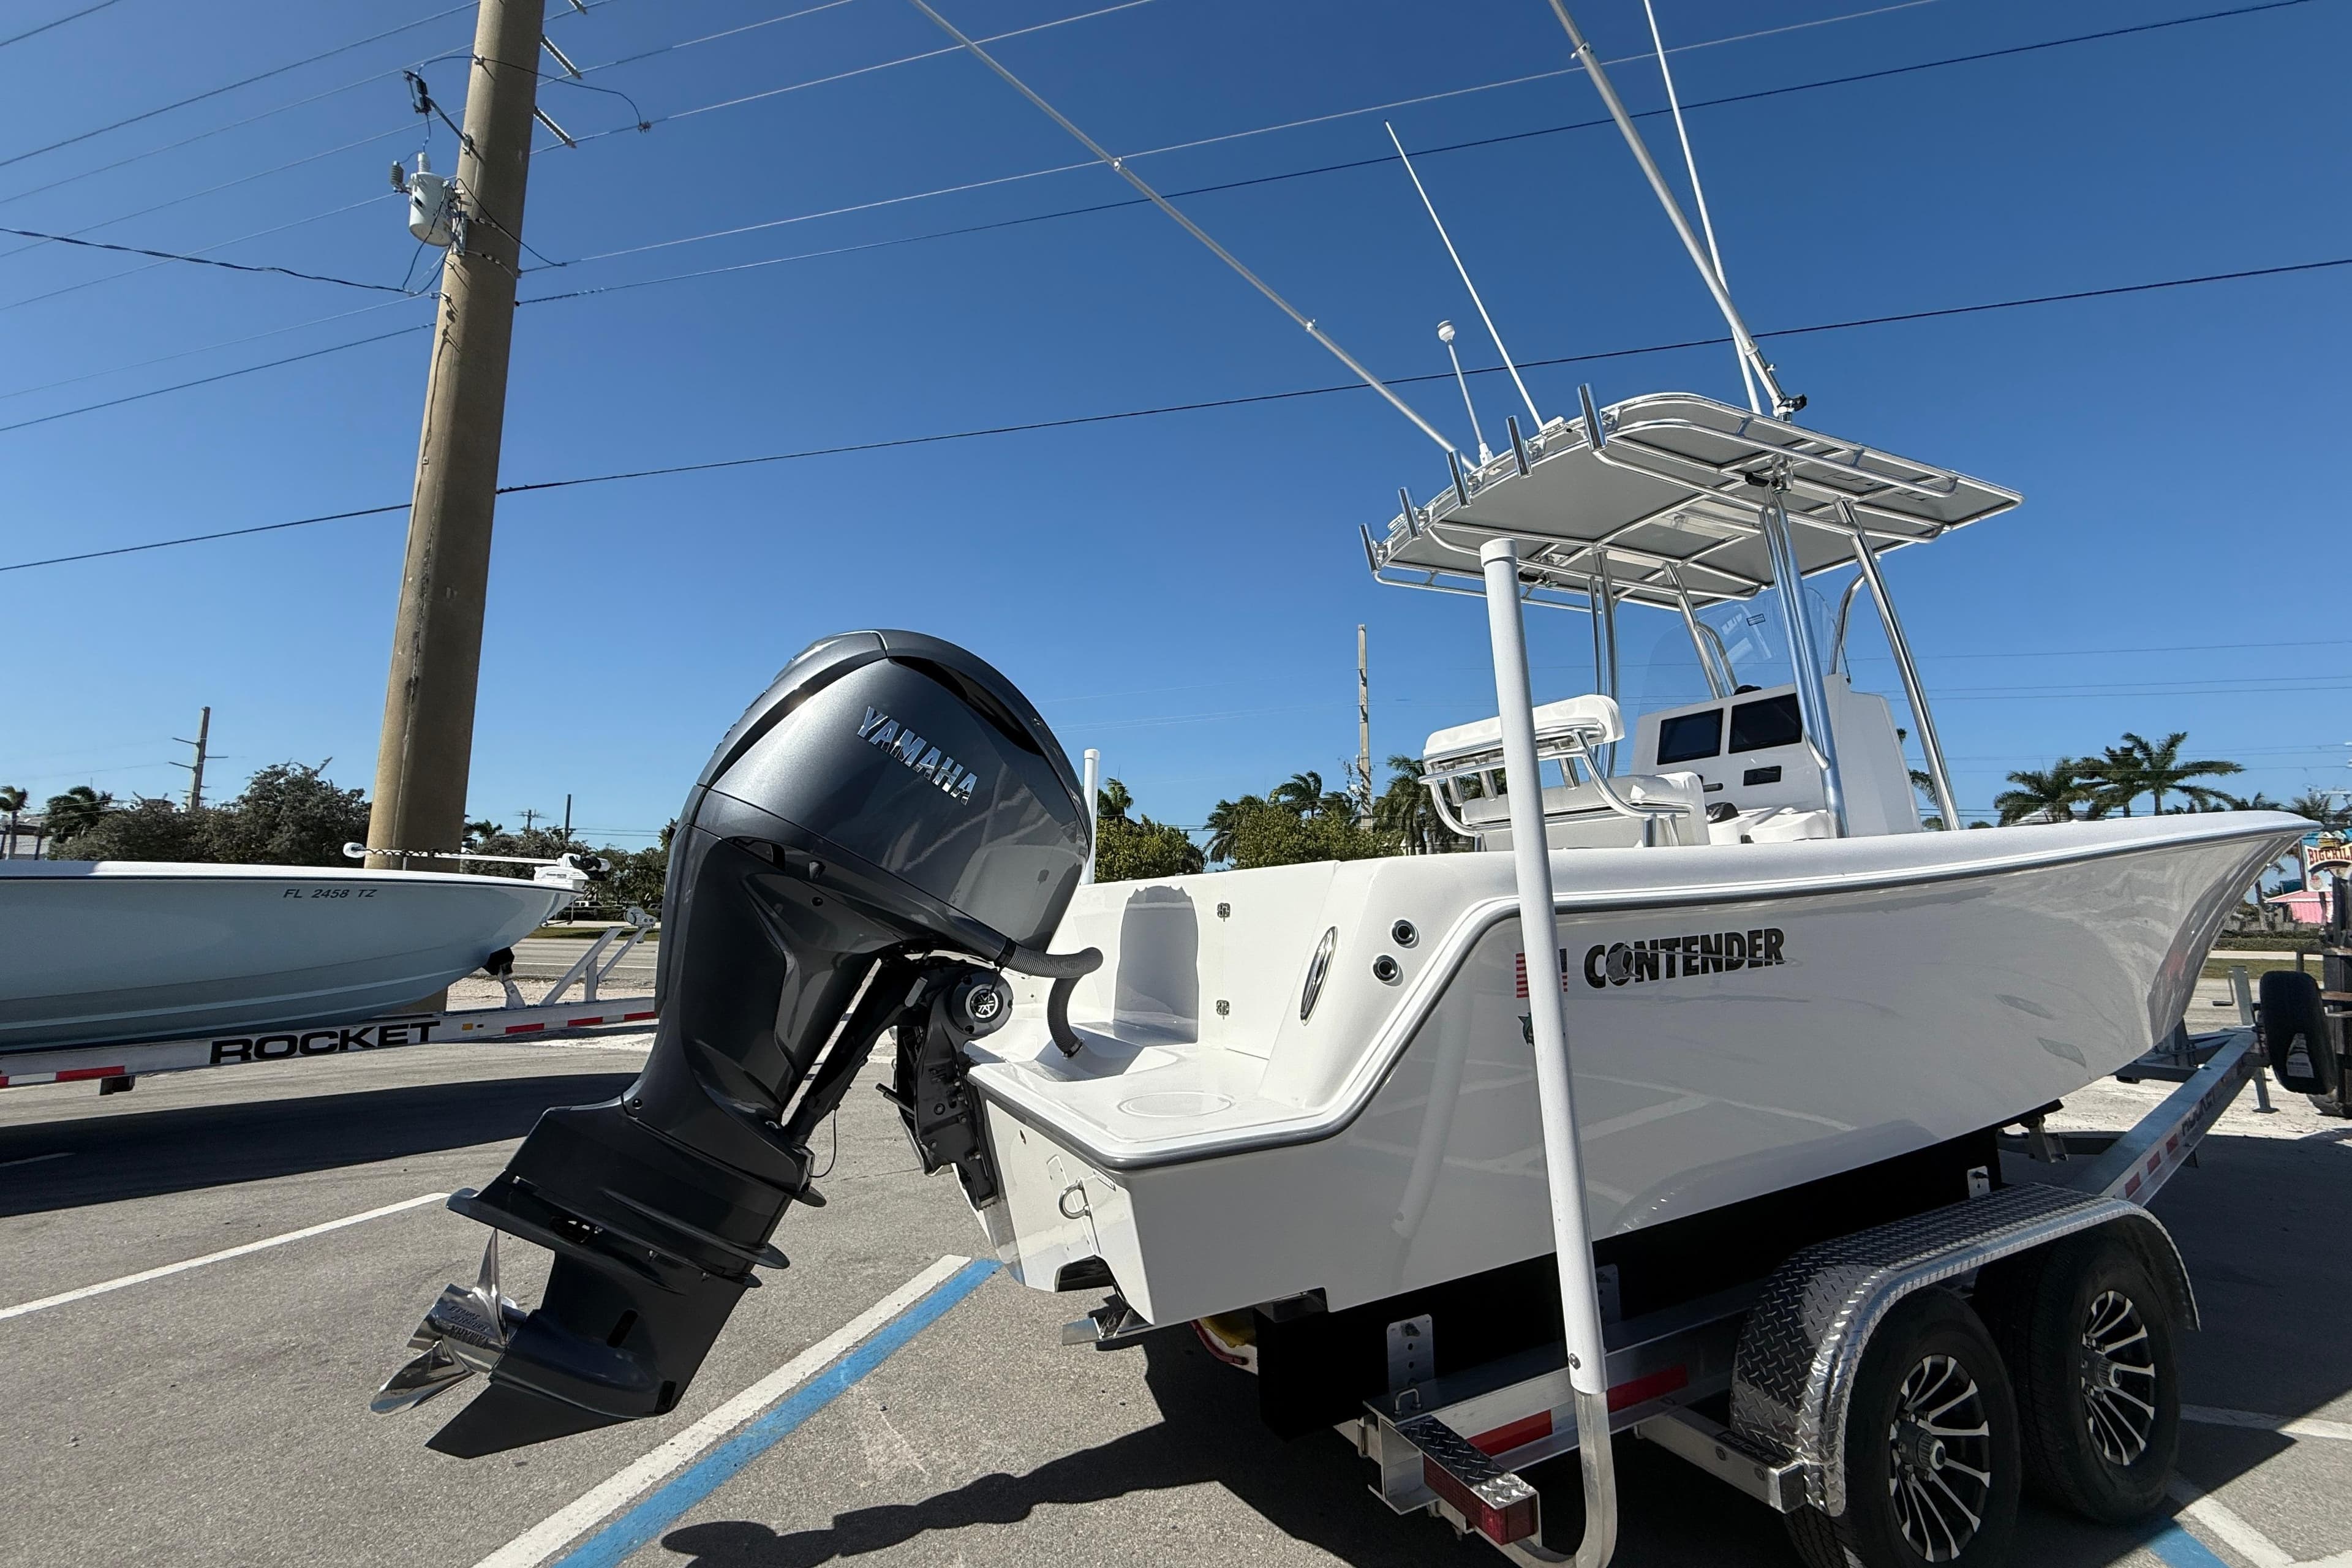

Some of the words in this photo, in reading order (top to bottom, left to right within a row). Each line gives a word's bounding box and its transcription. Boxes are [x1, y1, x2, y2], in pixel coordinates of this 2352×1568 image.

[858, 706, 978, 806] YAMAHA
[283, 889, 303, 899] FL
[311, 889, 350, 899] 2458
[358, 889, 378, 898] TZ
[1584, 928, 1785, 989] CONTENDER
[209, 1020, 441, 1065] ROCKET
